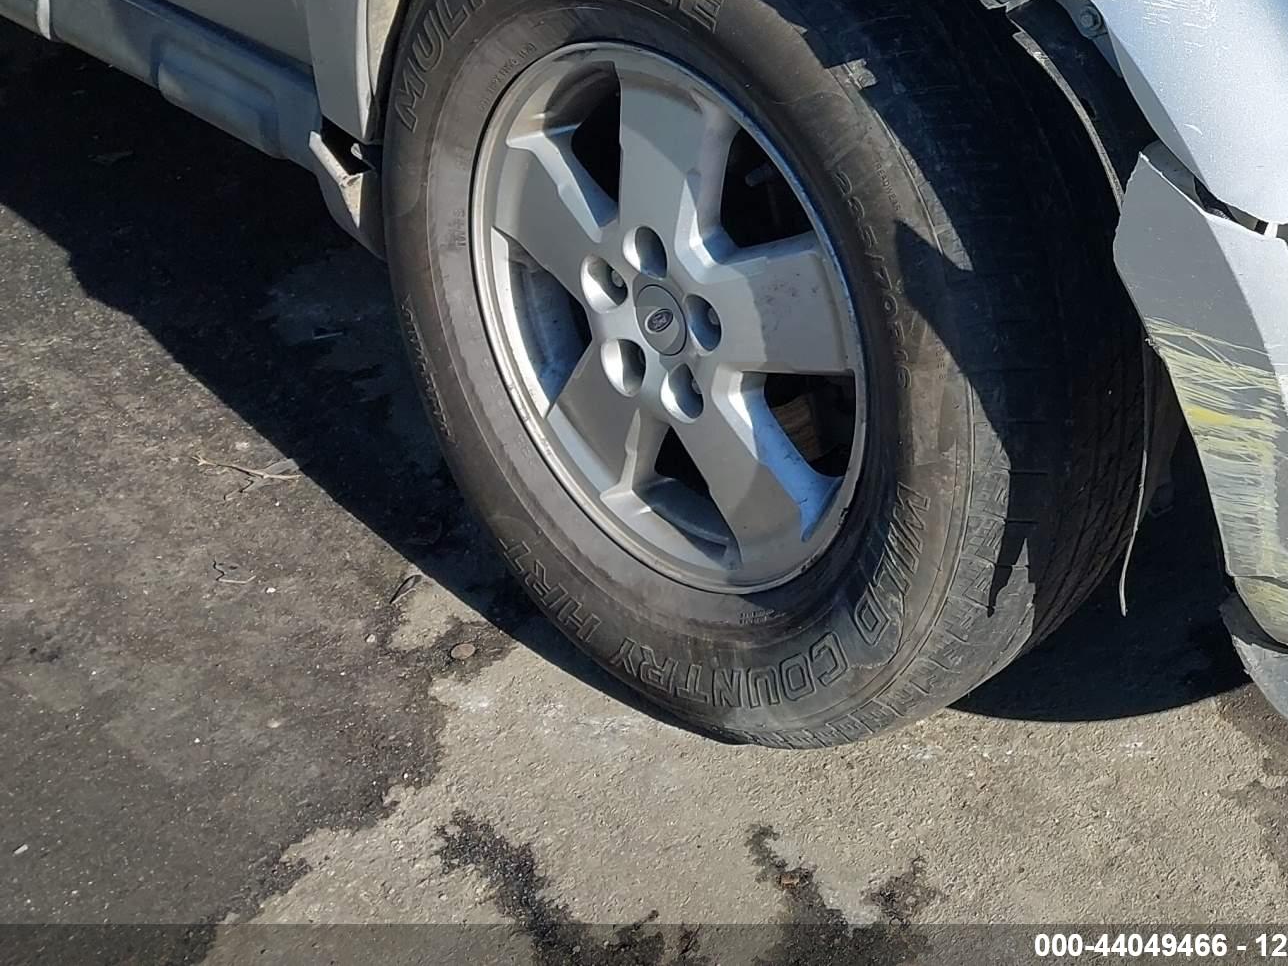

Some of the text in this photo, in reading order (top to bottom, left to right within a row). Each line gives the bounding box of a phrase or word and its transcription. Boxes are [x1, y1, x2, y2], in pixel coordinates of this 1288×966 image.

[497, 481, 931, 709] WILD COUNTRY HRT
